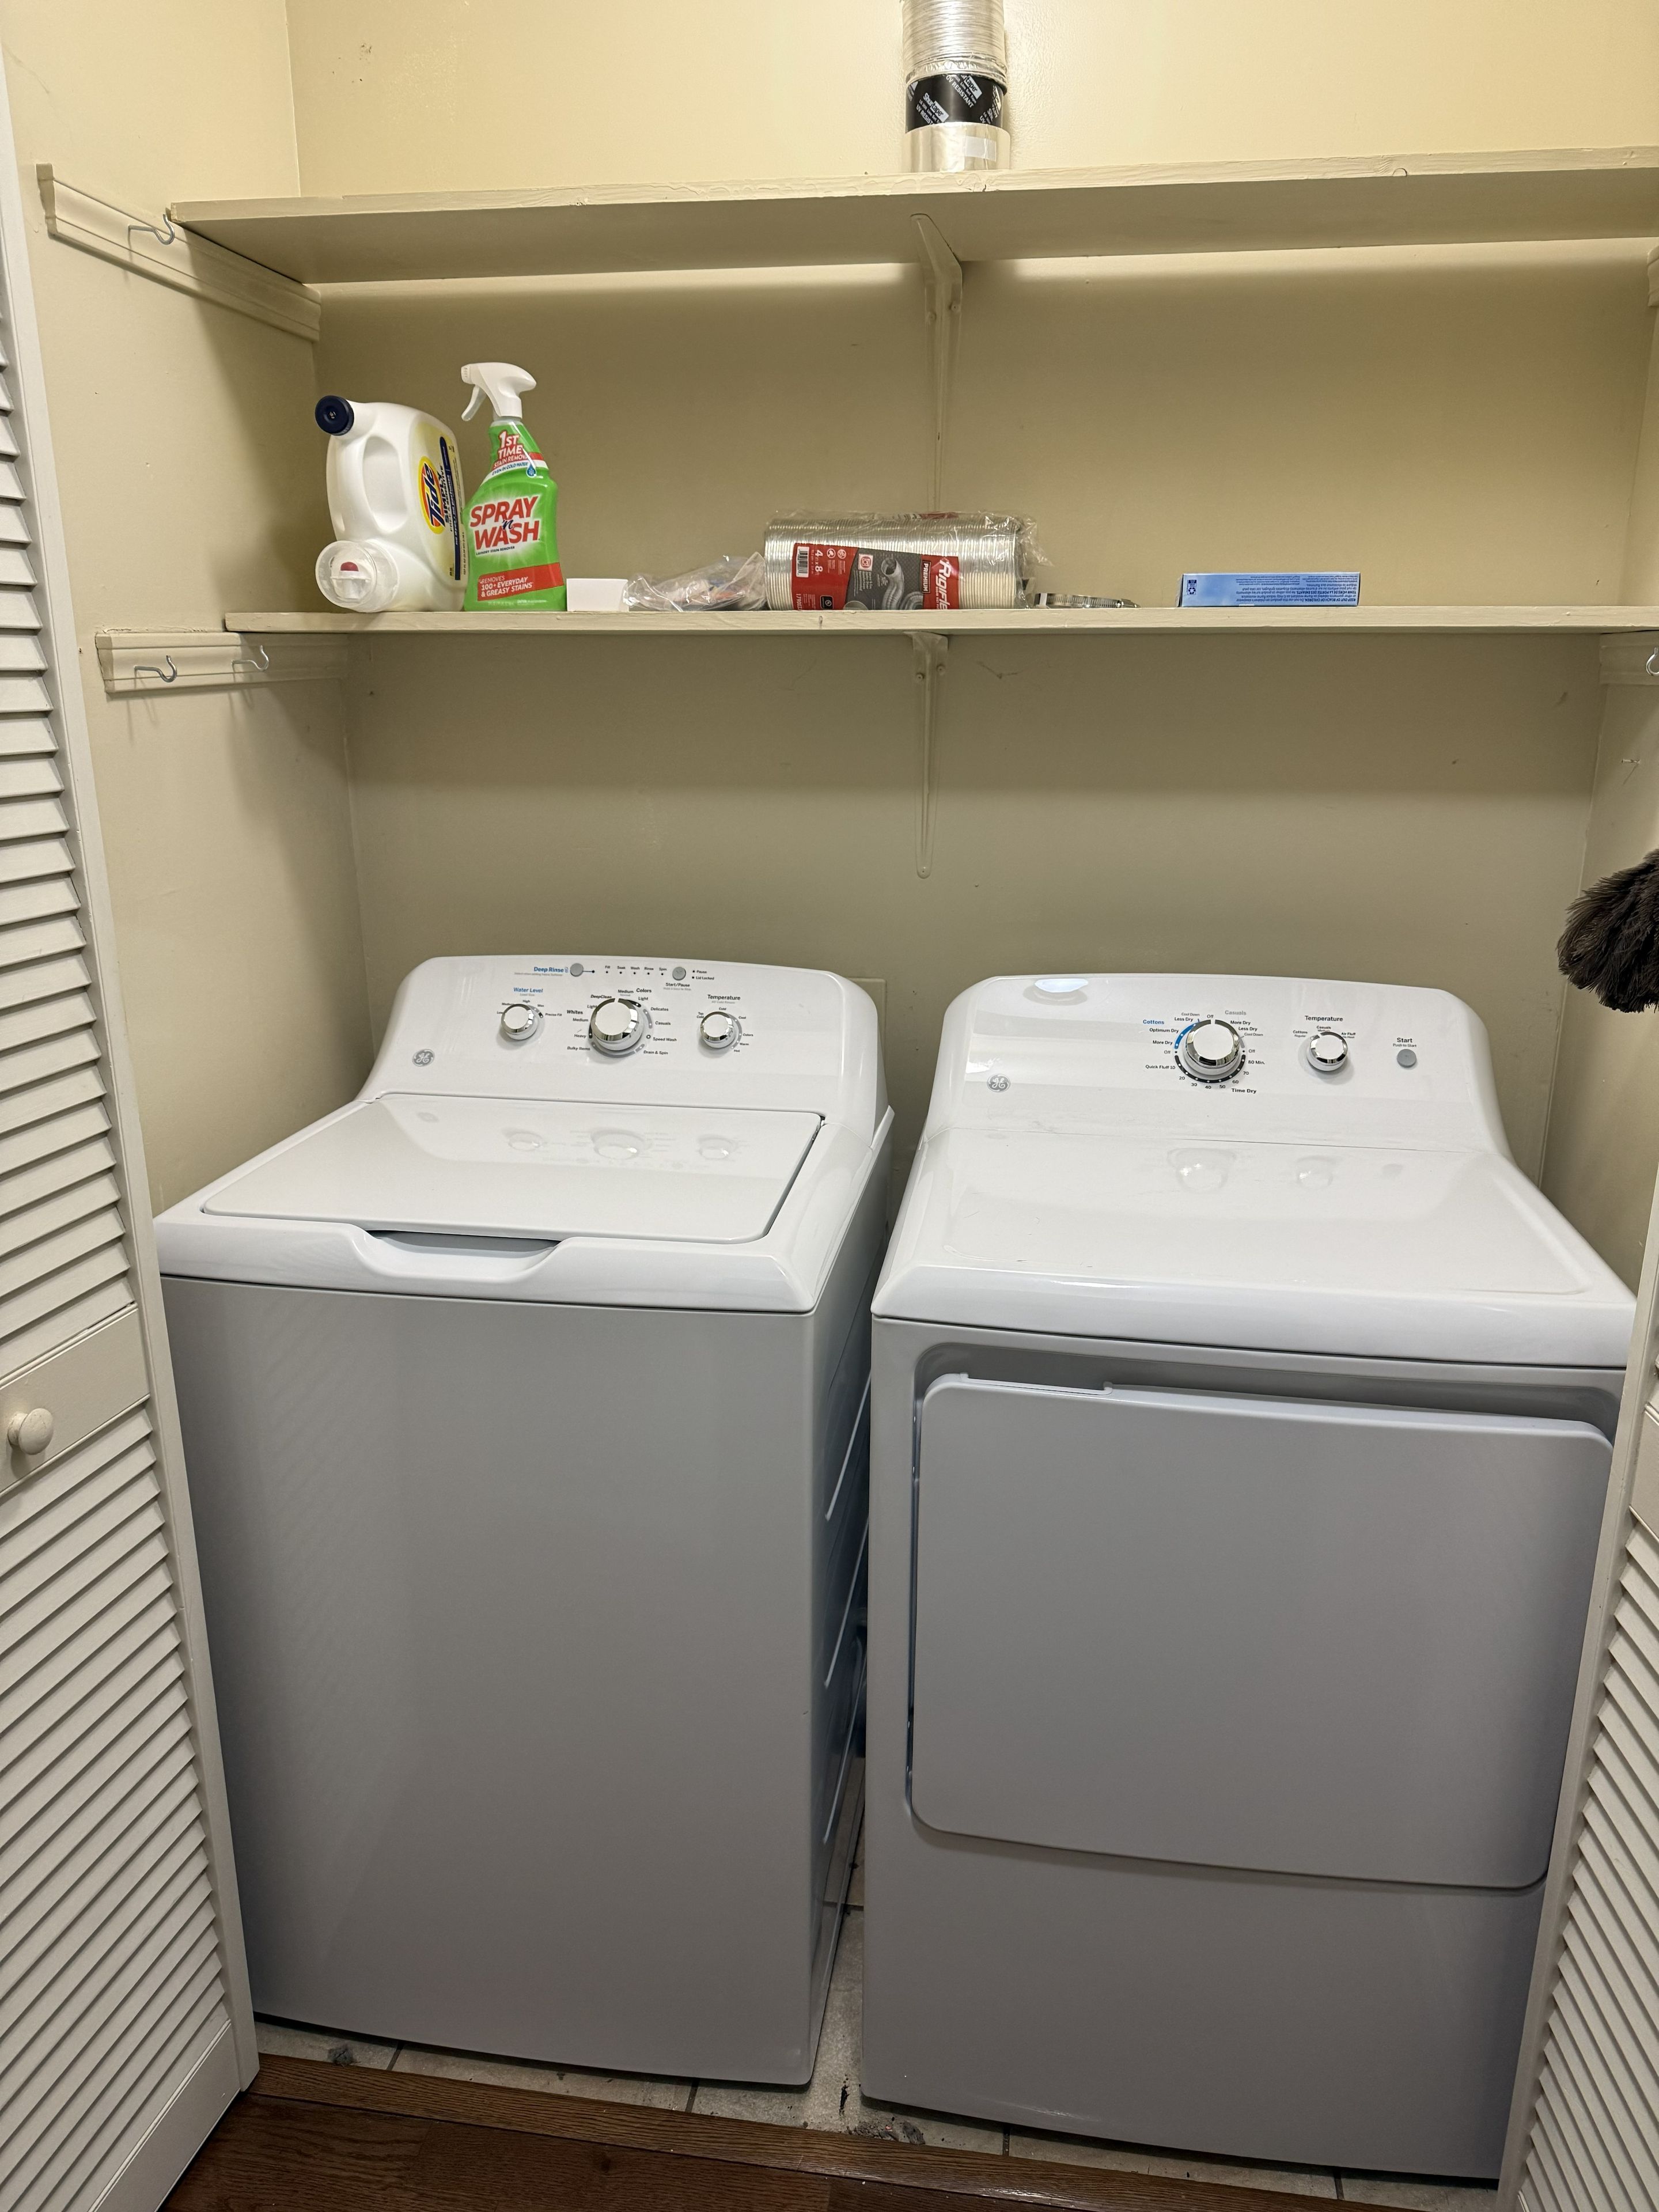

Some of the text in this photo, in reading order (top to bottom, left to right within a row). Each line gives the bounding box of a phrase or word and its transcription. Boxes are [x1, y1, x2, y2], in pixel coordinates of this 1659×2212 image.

[952, 81, 974, 108] RESISTANT
[923, 92, 944, 116] Shurtape
[921, 110, 933, 124] RESIST
[499, 431, 519, 448] 1ST
[498, 445, 523, 459] TIME
[494, 457, 507, 468] STAIN
[425, 463, 445, 527] Tide
[437, 471, 449, 523] SIMPLY
[470, 496, 539, 527] SPRAY
[475, 520, 539, 550] WASH
[482, 575, 505, 584] REMOVES
[497, 577, 528, 588] EVERYDAY
[487, 588, 509, 596] GREASY
